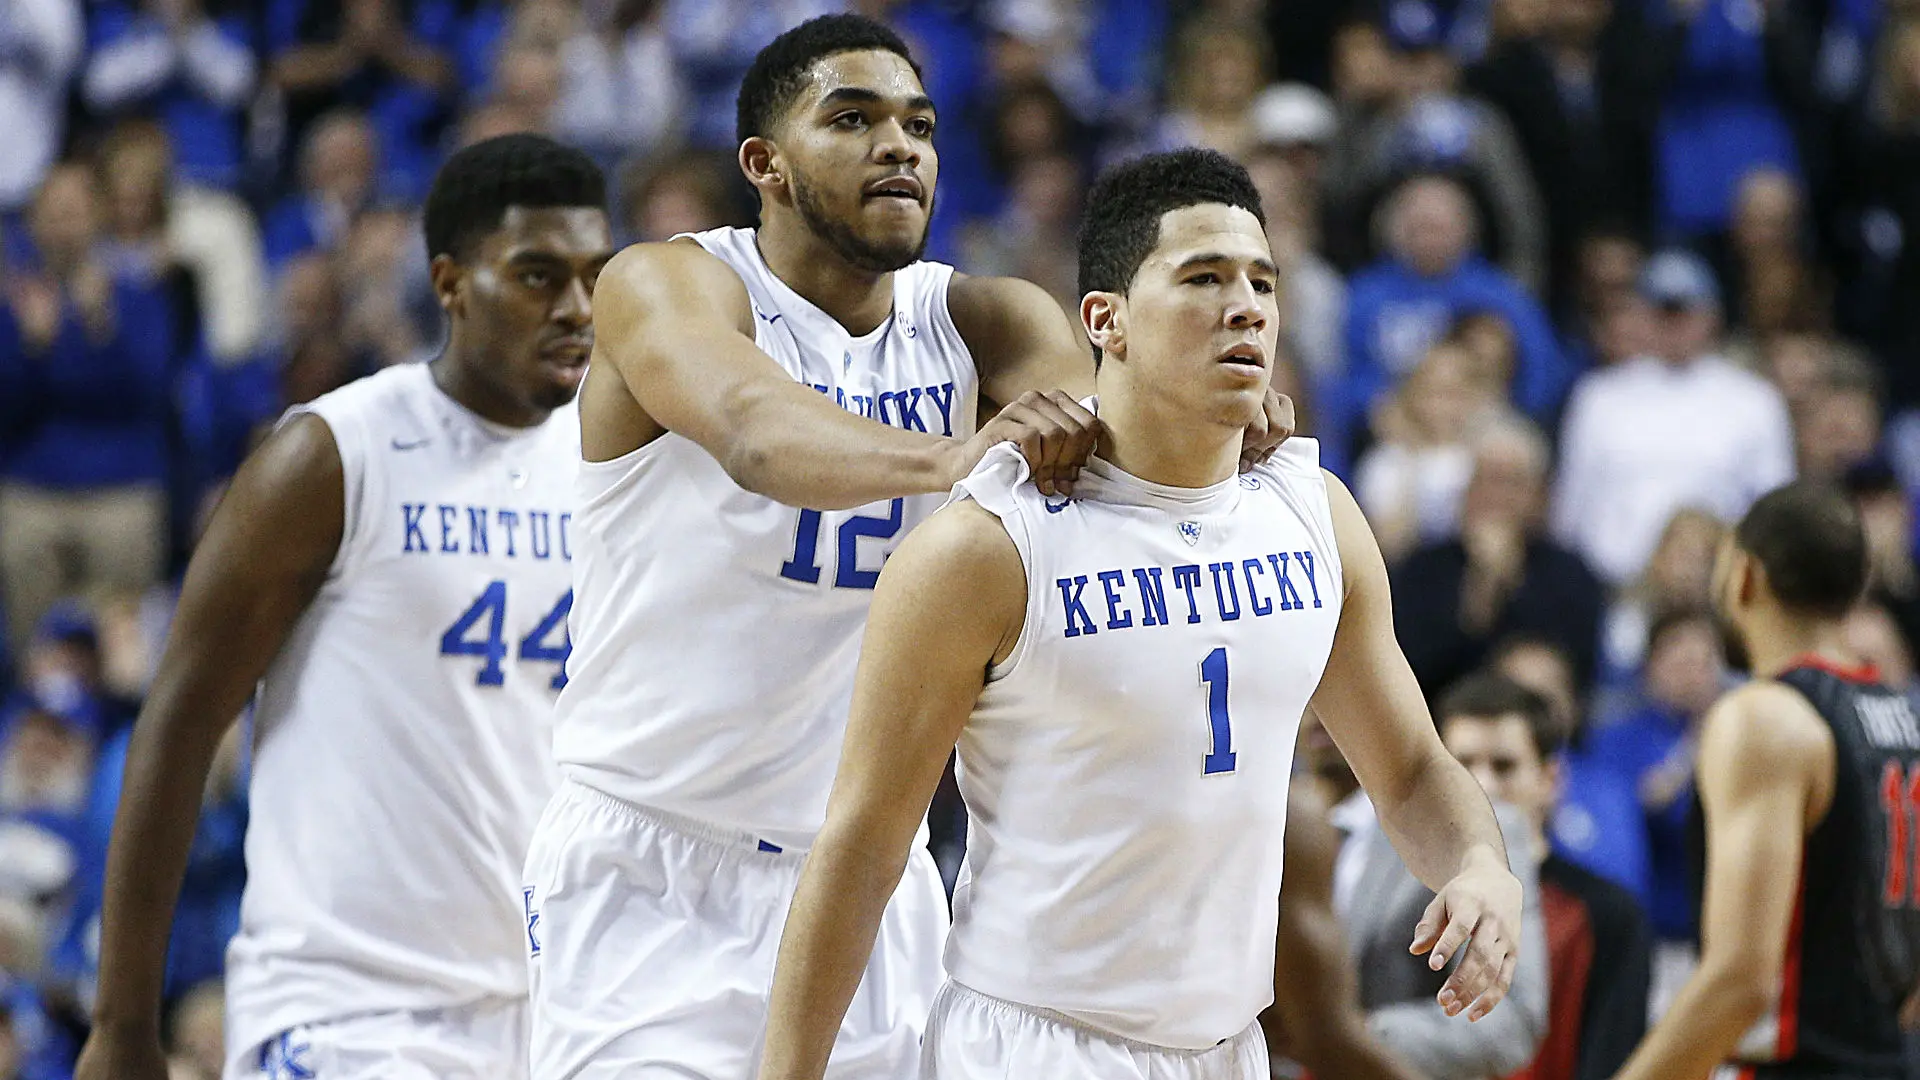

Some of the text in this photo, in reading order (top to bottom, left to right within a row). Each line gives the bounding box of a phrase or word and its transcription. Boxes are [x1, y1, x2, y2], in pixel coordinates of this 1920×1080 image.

[440, 579, 573, 690] 44
[1056, 551, 1323, 638] KENTUCKY
[1201, 647, 1237, 775] 1
